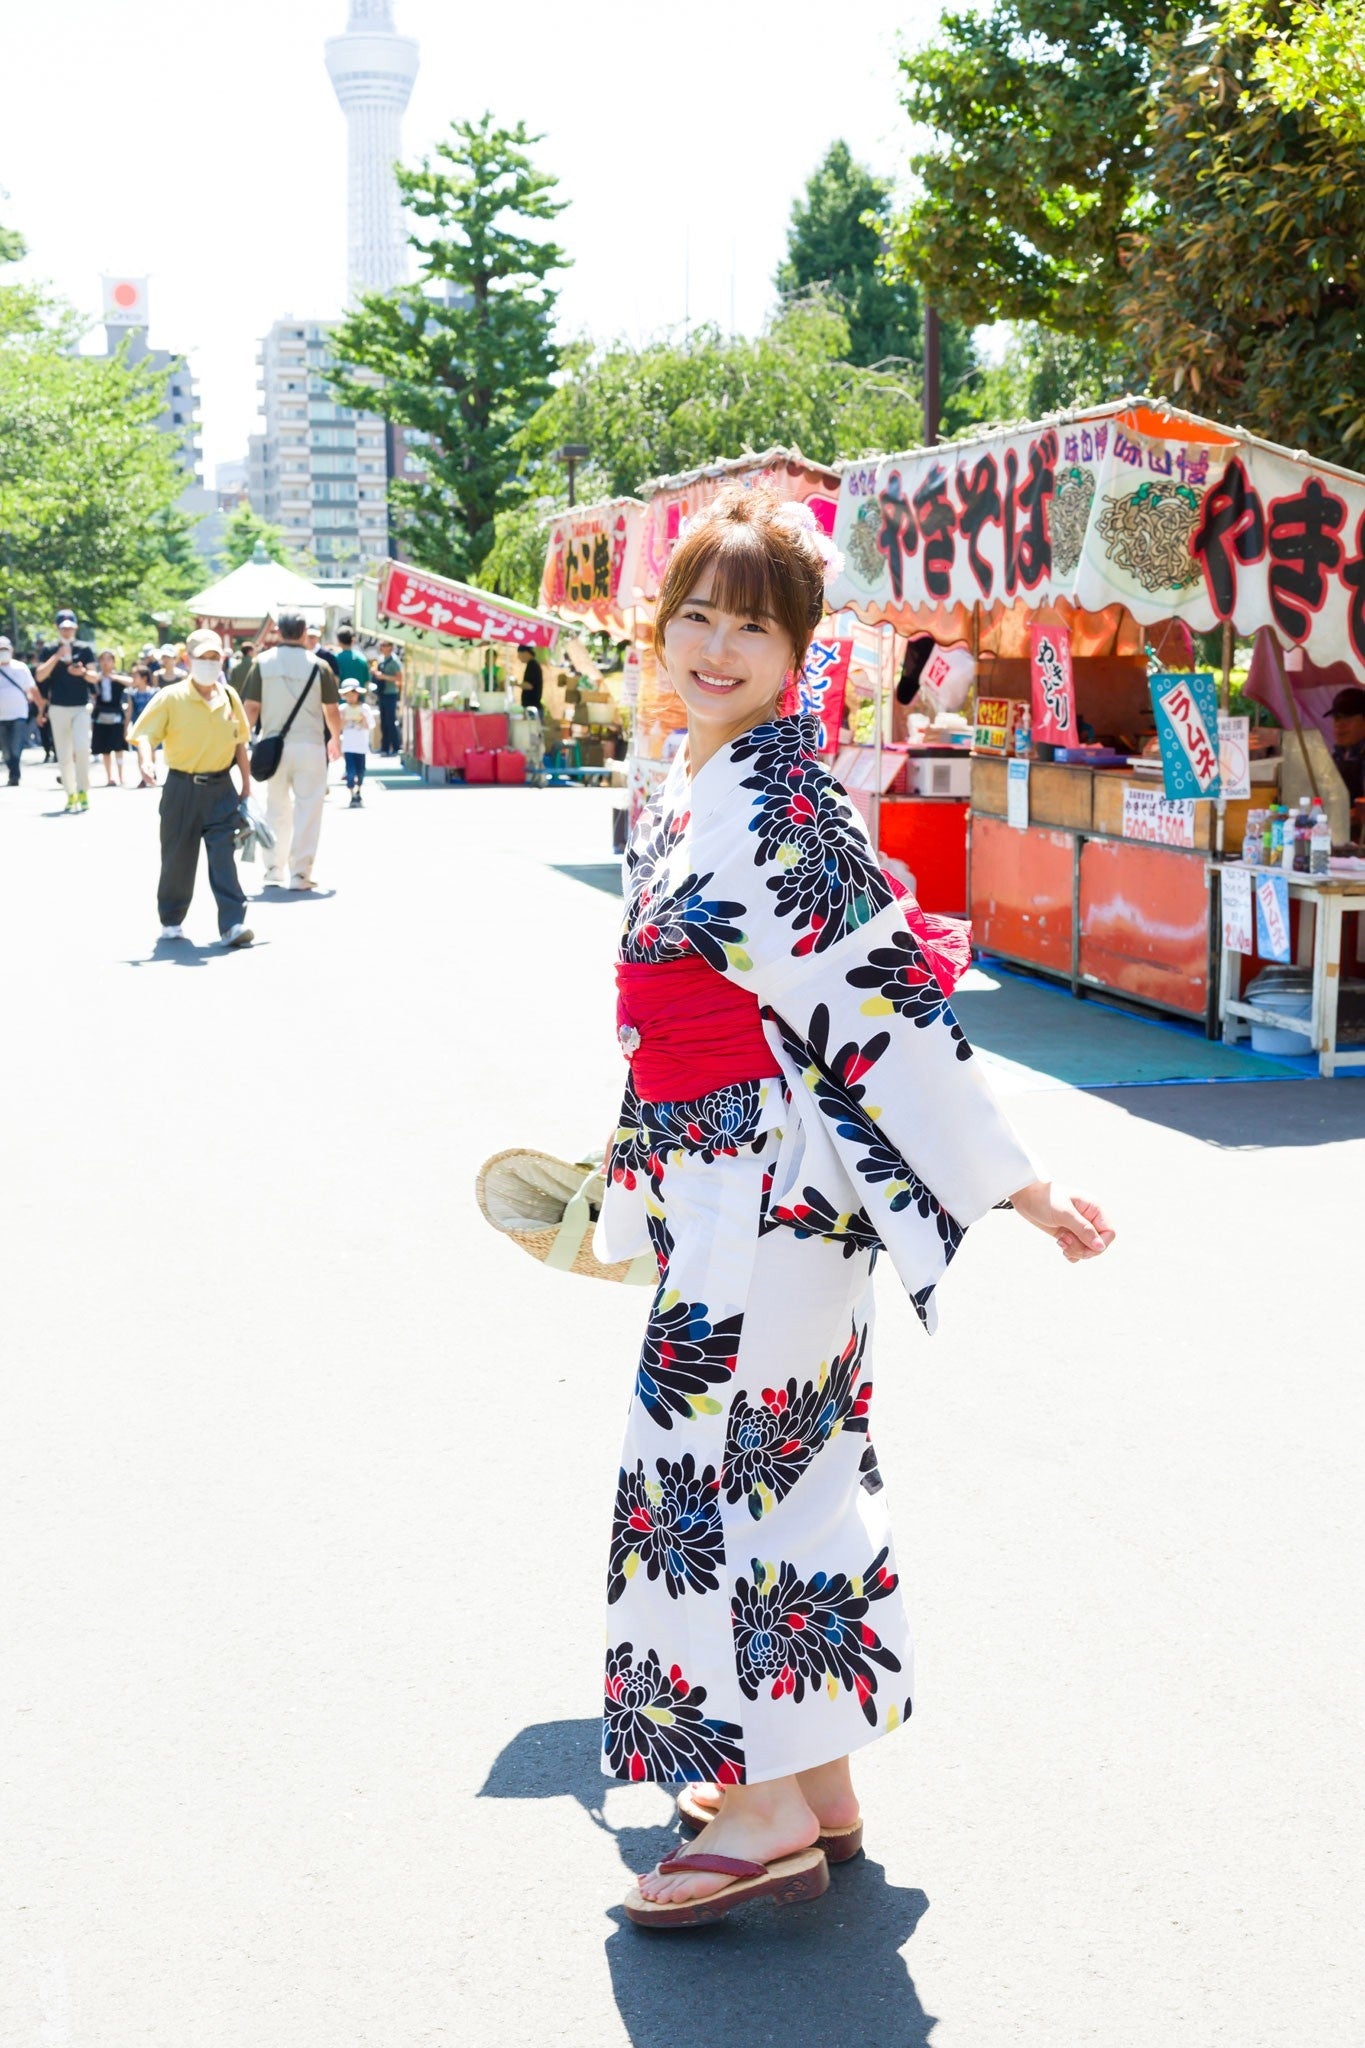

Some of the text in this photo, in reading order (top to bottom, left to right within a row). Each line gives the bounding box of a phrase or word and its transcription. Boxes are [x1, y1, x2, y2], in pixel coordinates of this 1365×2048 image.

[877, 428, 1059, 601] やきそば
[1188, 455, 1365, 667] やき
[1035, 636, 1069, 731] やきとり
[1167, 690, 1215, 780] ラムネ
